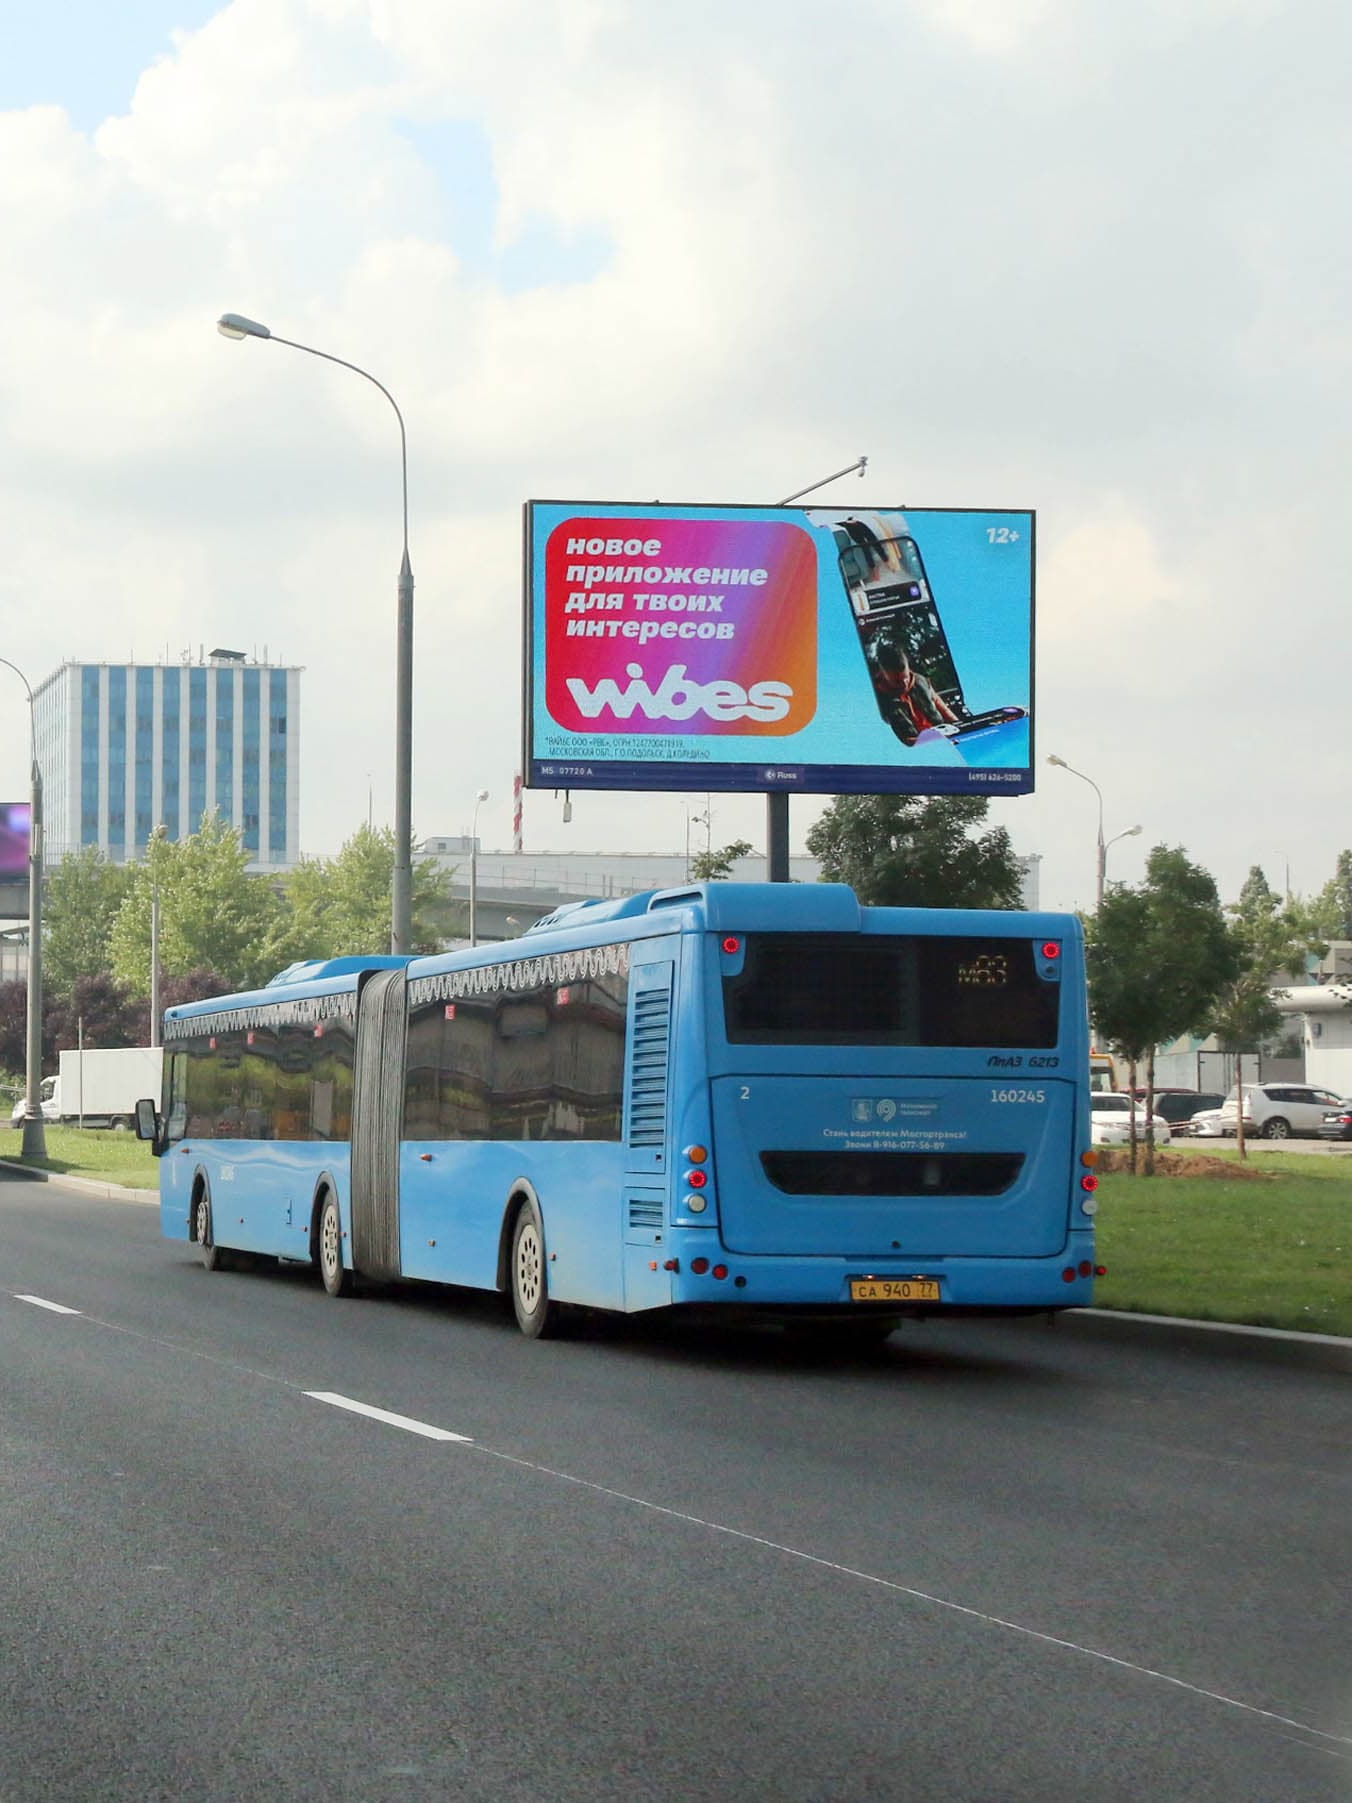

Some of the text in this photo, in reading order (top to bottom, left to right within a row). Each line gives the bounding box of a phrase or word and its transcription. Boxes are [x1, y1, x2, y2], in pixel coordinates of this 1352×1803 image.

[986, 527, 1019, 544] 12+
[566, 538, 662, 556] новое
[566, 565, 768, 589] приложение
[565, 592, 725, 613] для твоих
[566, 619, 735, 645] интересов
[565, 662, 794, 722] wibes
[777, 771, 797, 779] Russ
[1028, 1056, 1060, 1068] 6213
[740, 1086, 750, 1100] 2
[991, 1089, 1046, 1103] 160245
[883, 1283, 911, 1297] 940
[919, 1283, 933, 1294] 77
